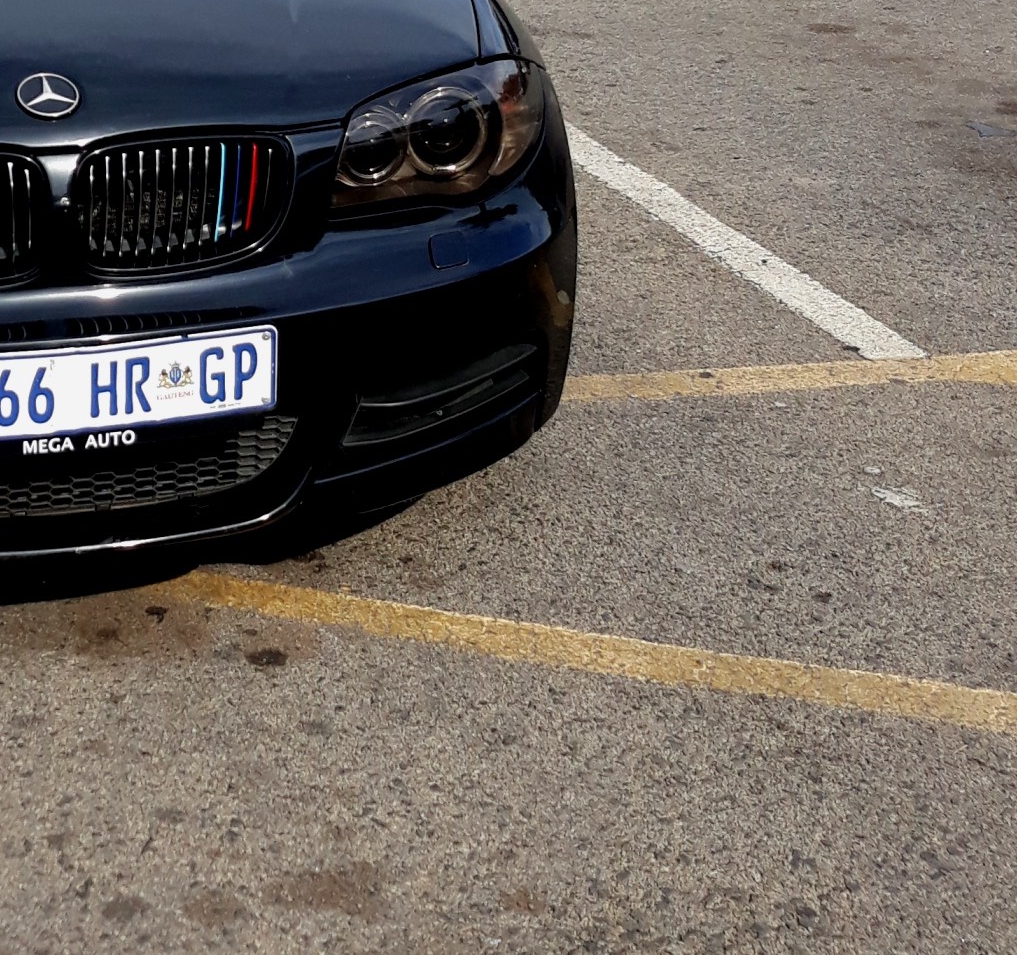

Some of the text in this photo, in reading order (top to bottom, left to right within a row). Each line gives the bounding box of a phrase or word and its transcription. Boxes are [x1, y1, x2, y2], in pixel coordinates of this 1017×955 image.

[90, 356, 152, 418] HR
[199, 342, 258, 405] GP
[22, 429, 136, 455] MEGA AUTO
